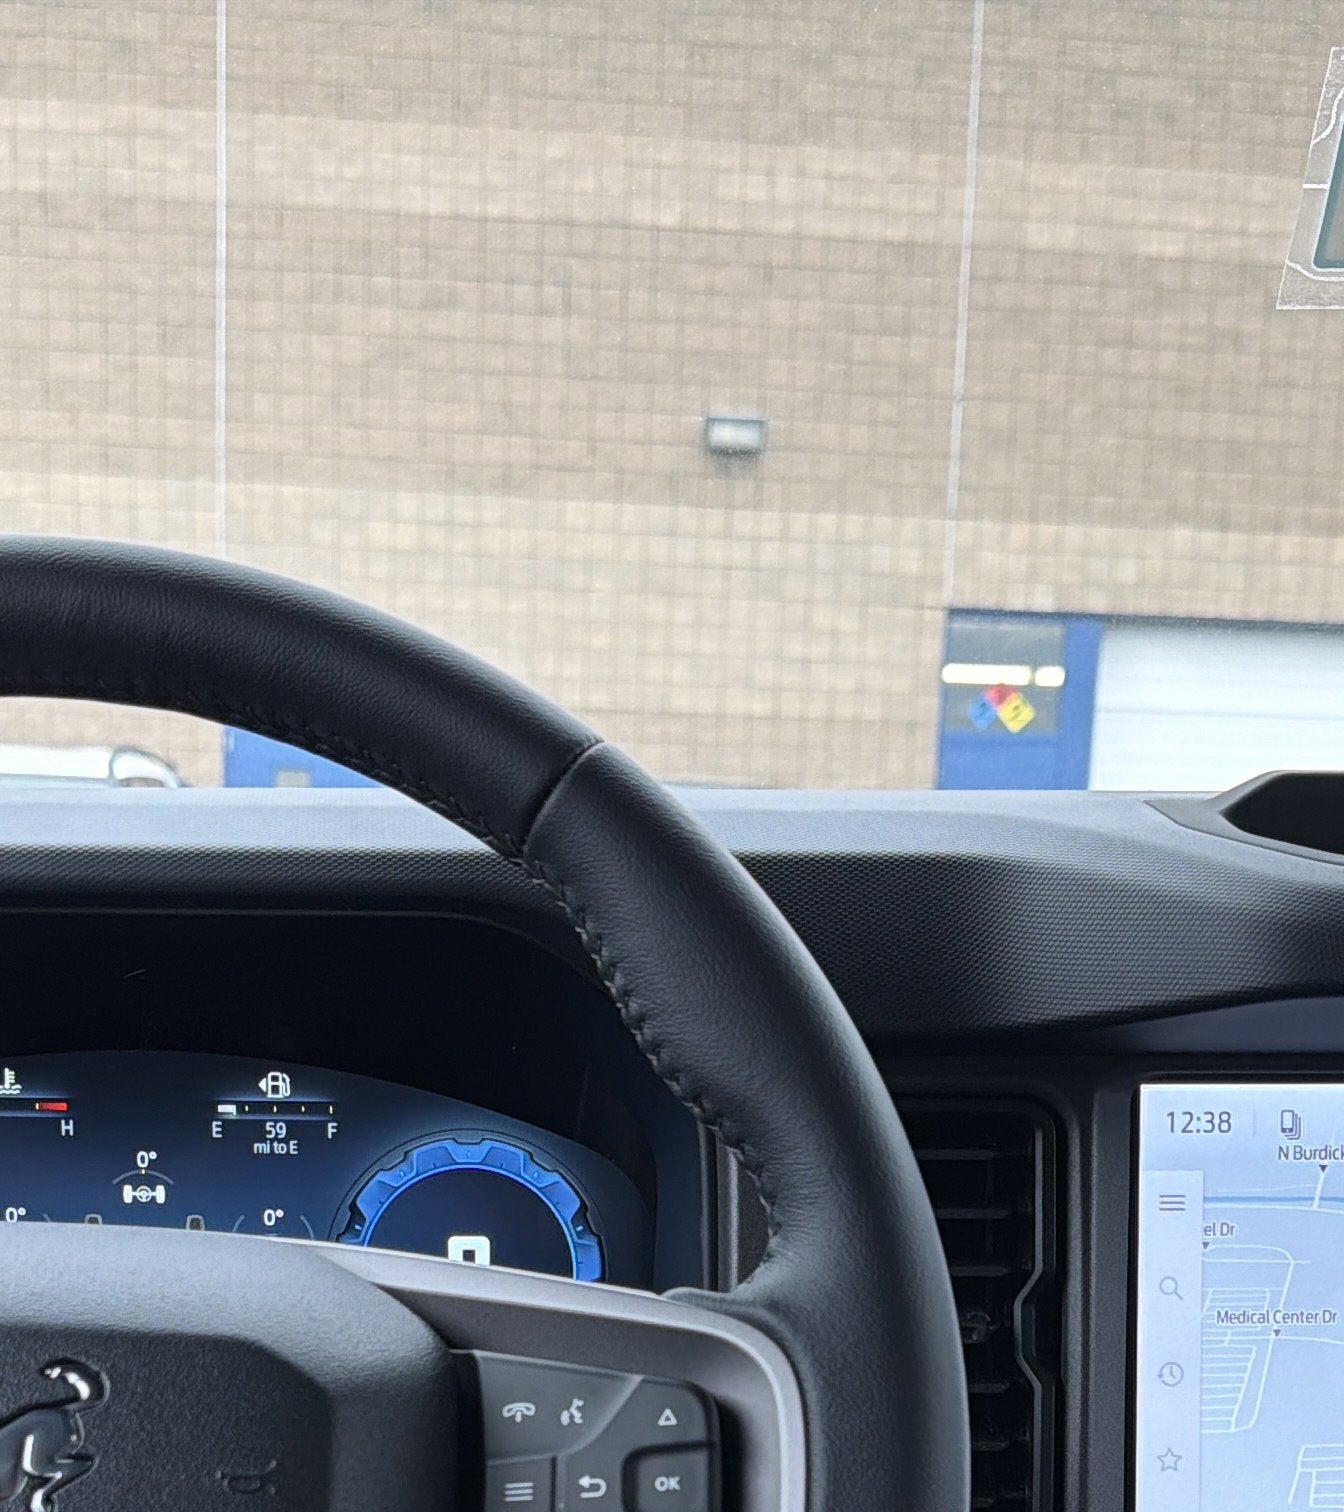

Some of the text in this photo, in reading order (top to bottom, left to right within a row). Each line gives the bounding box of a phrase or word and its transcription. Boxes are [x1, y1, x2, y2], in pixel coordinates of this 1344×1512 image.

[61, 1120, 74, 1136] H
[212, 1122, 338, 1138] E 59 F
[1165, 1110, 1232, 1135] 12:38
[254, 1141, 299, 1155] mi to E
[1278, 1145, 1289, 1161] N
[136, 1152, 157, 1168] 0°
[1219, 1222, 1236, 1237] Dr
[1216, 1309, 1338, 1326] Medical Center Dr
[654, 1476, 680, 1492] OK
